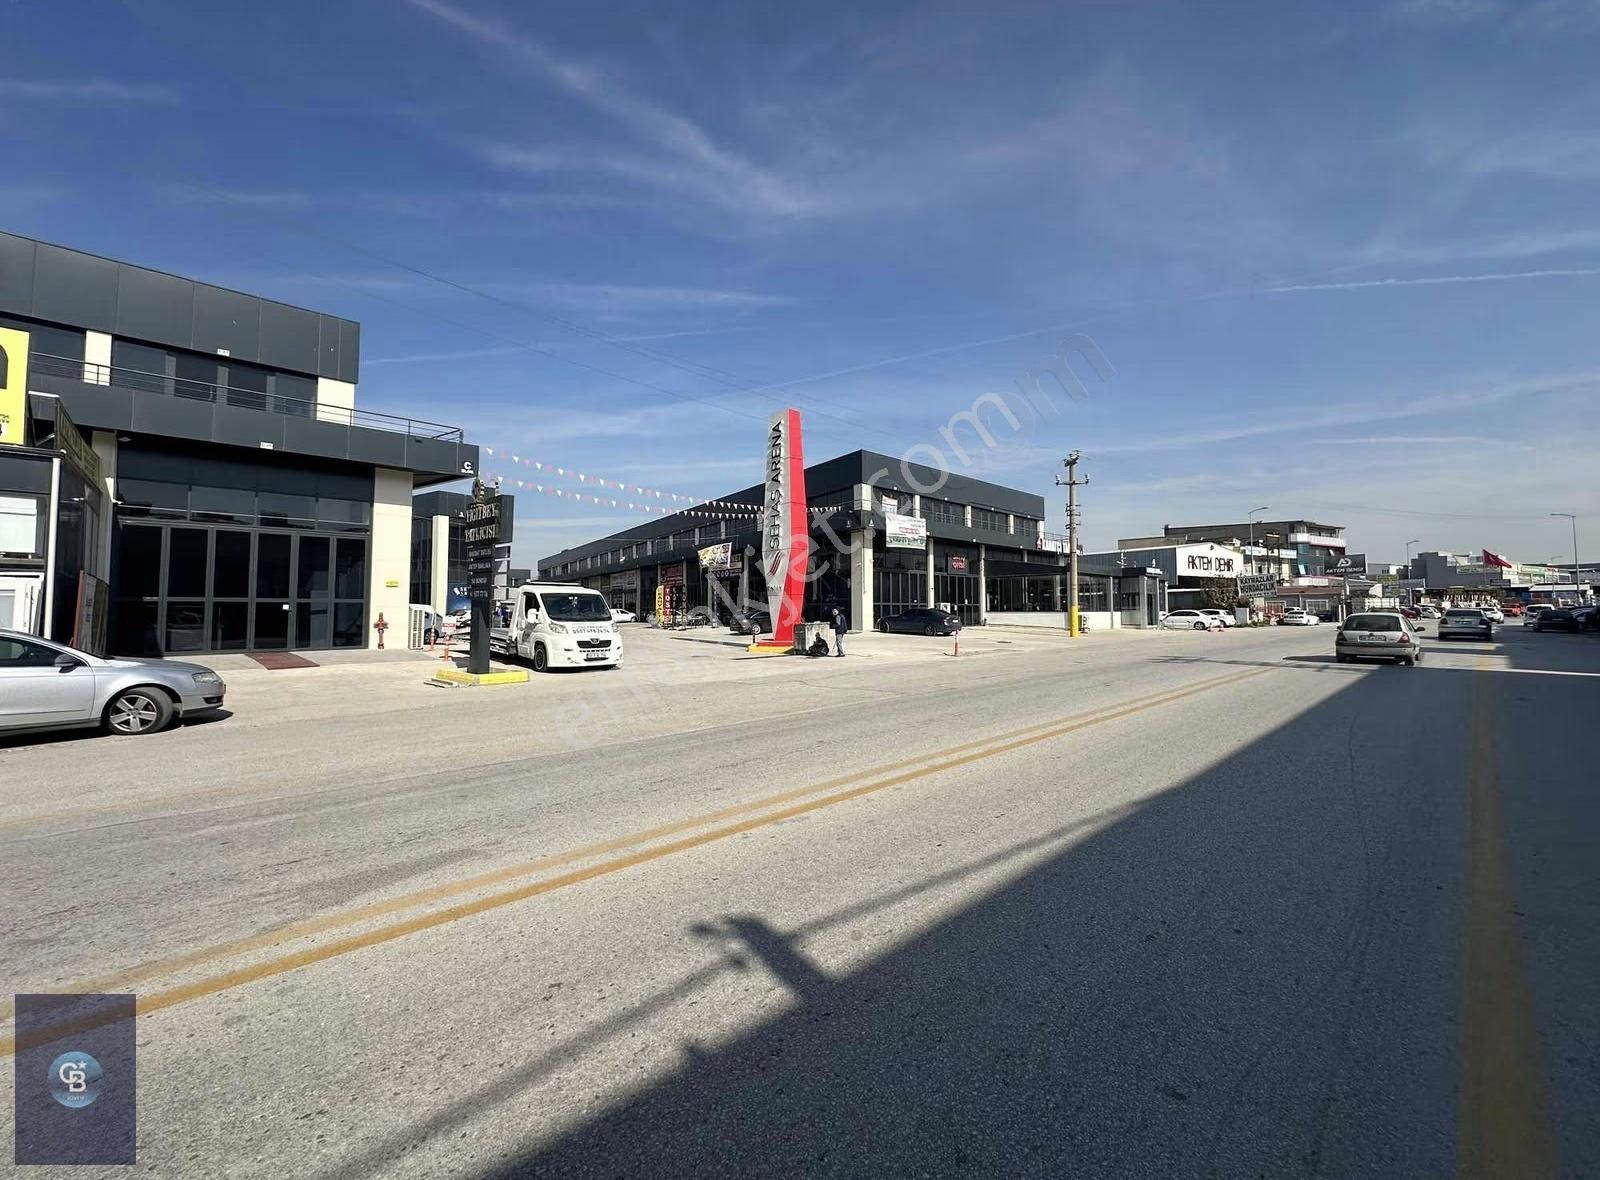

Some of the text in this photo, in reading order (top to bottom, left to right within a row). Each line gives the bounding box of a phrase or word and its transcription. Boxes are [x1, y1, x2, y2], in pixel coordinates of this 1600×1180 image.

[463, 461, 472, 469] C
[769, 420, 782, 549] SEHAŞ ARENA
[1187, 555, 1213, 571] AKTEM
[1240, 575, 1274, 585] KAYMAZLAR
[1240, 582, 1276, 594] HURDACILIK
